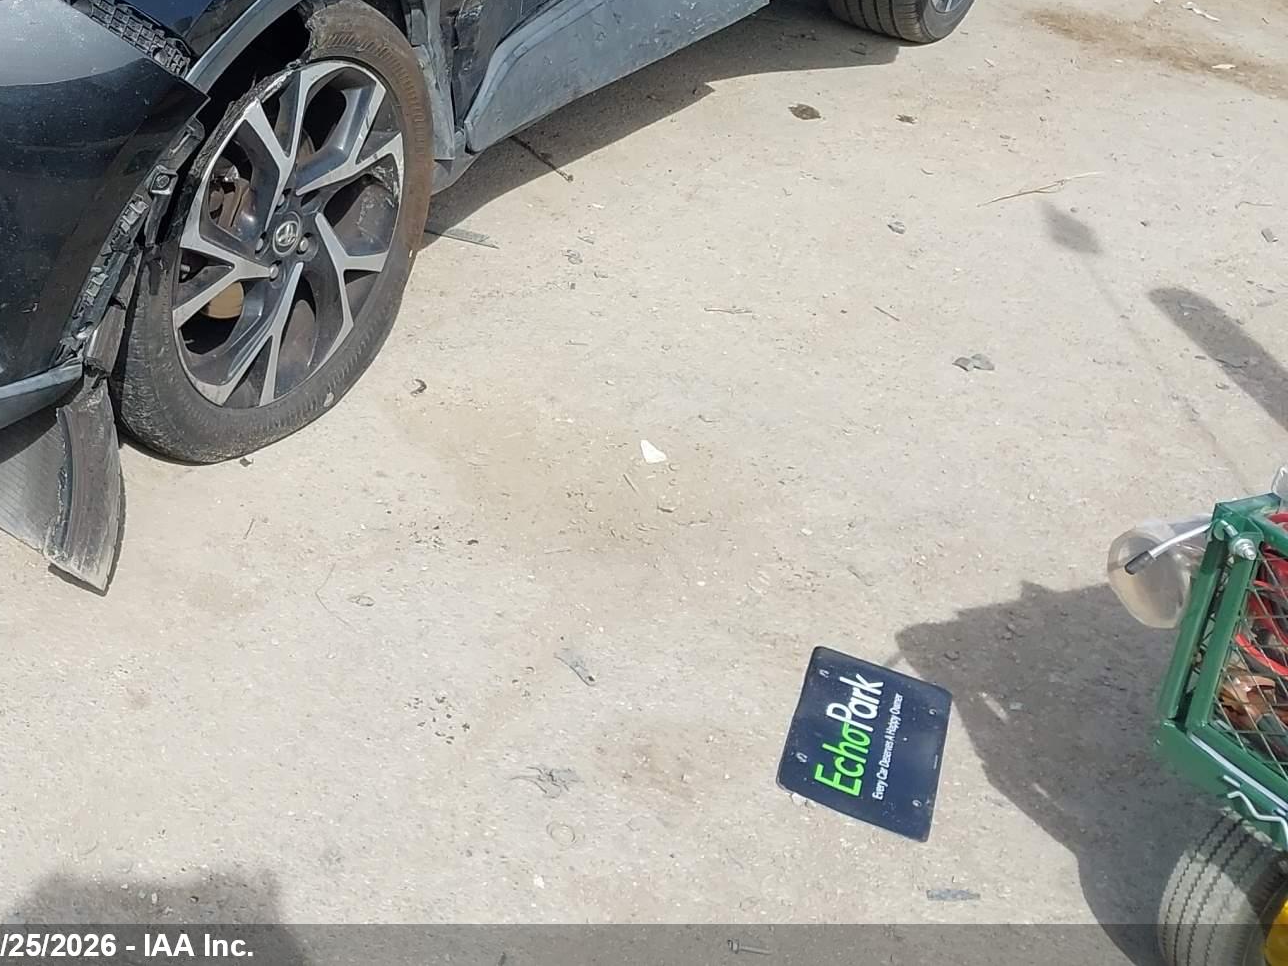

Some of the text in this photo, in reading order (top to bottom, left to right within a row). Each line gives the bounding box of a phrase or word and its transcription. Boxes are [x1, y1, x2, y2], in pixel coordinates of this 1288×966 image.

[889, 694, 903, 715] Owner
[814, 673, 885, 797] EchoPark
[886, 715, 901, 735] Happy
[879, 740, 894, 767] Deserves
[876, 766, 888, 780] Car
[871, 779, 888, 800] Every
